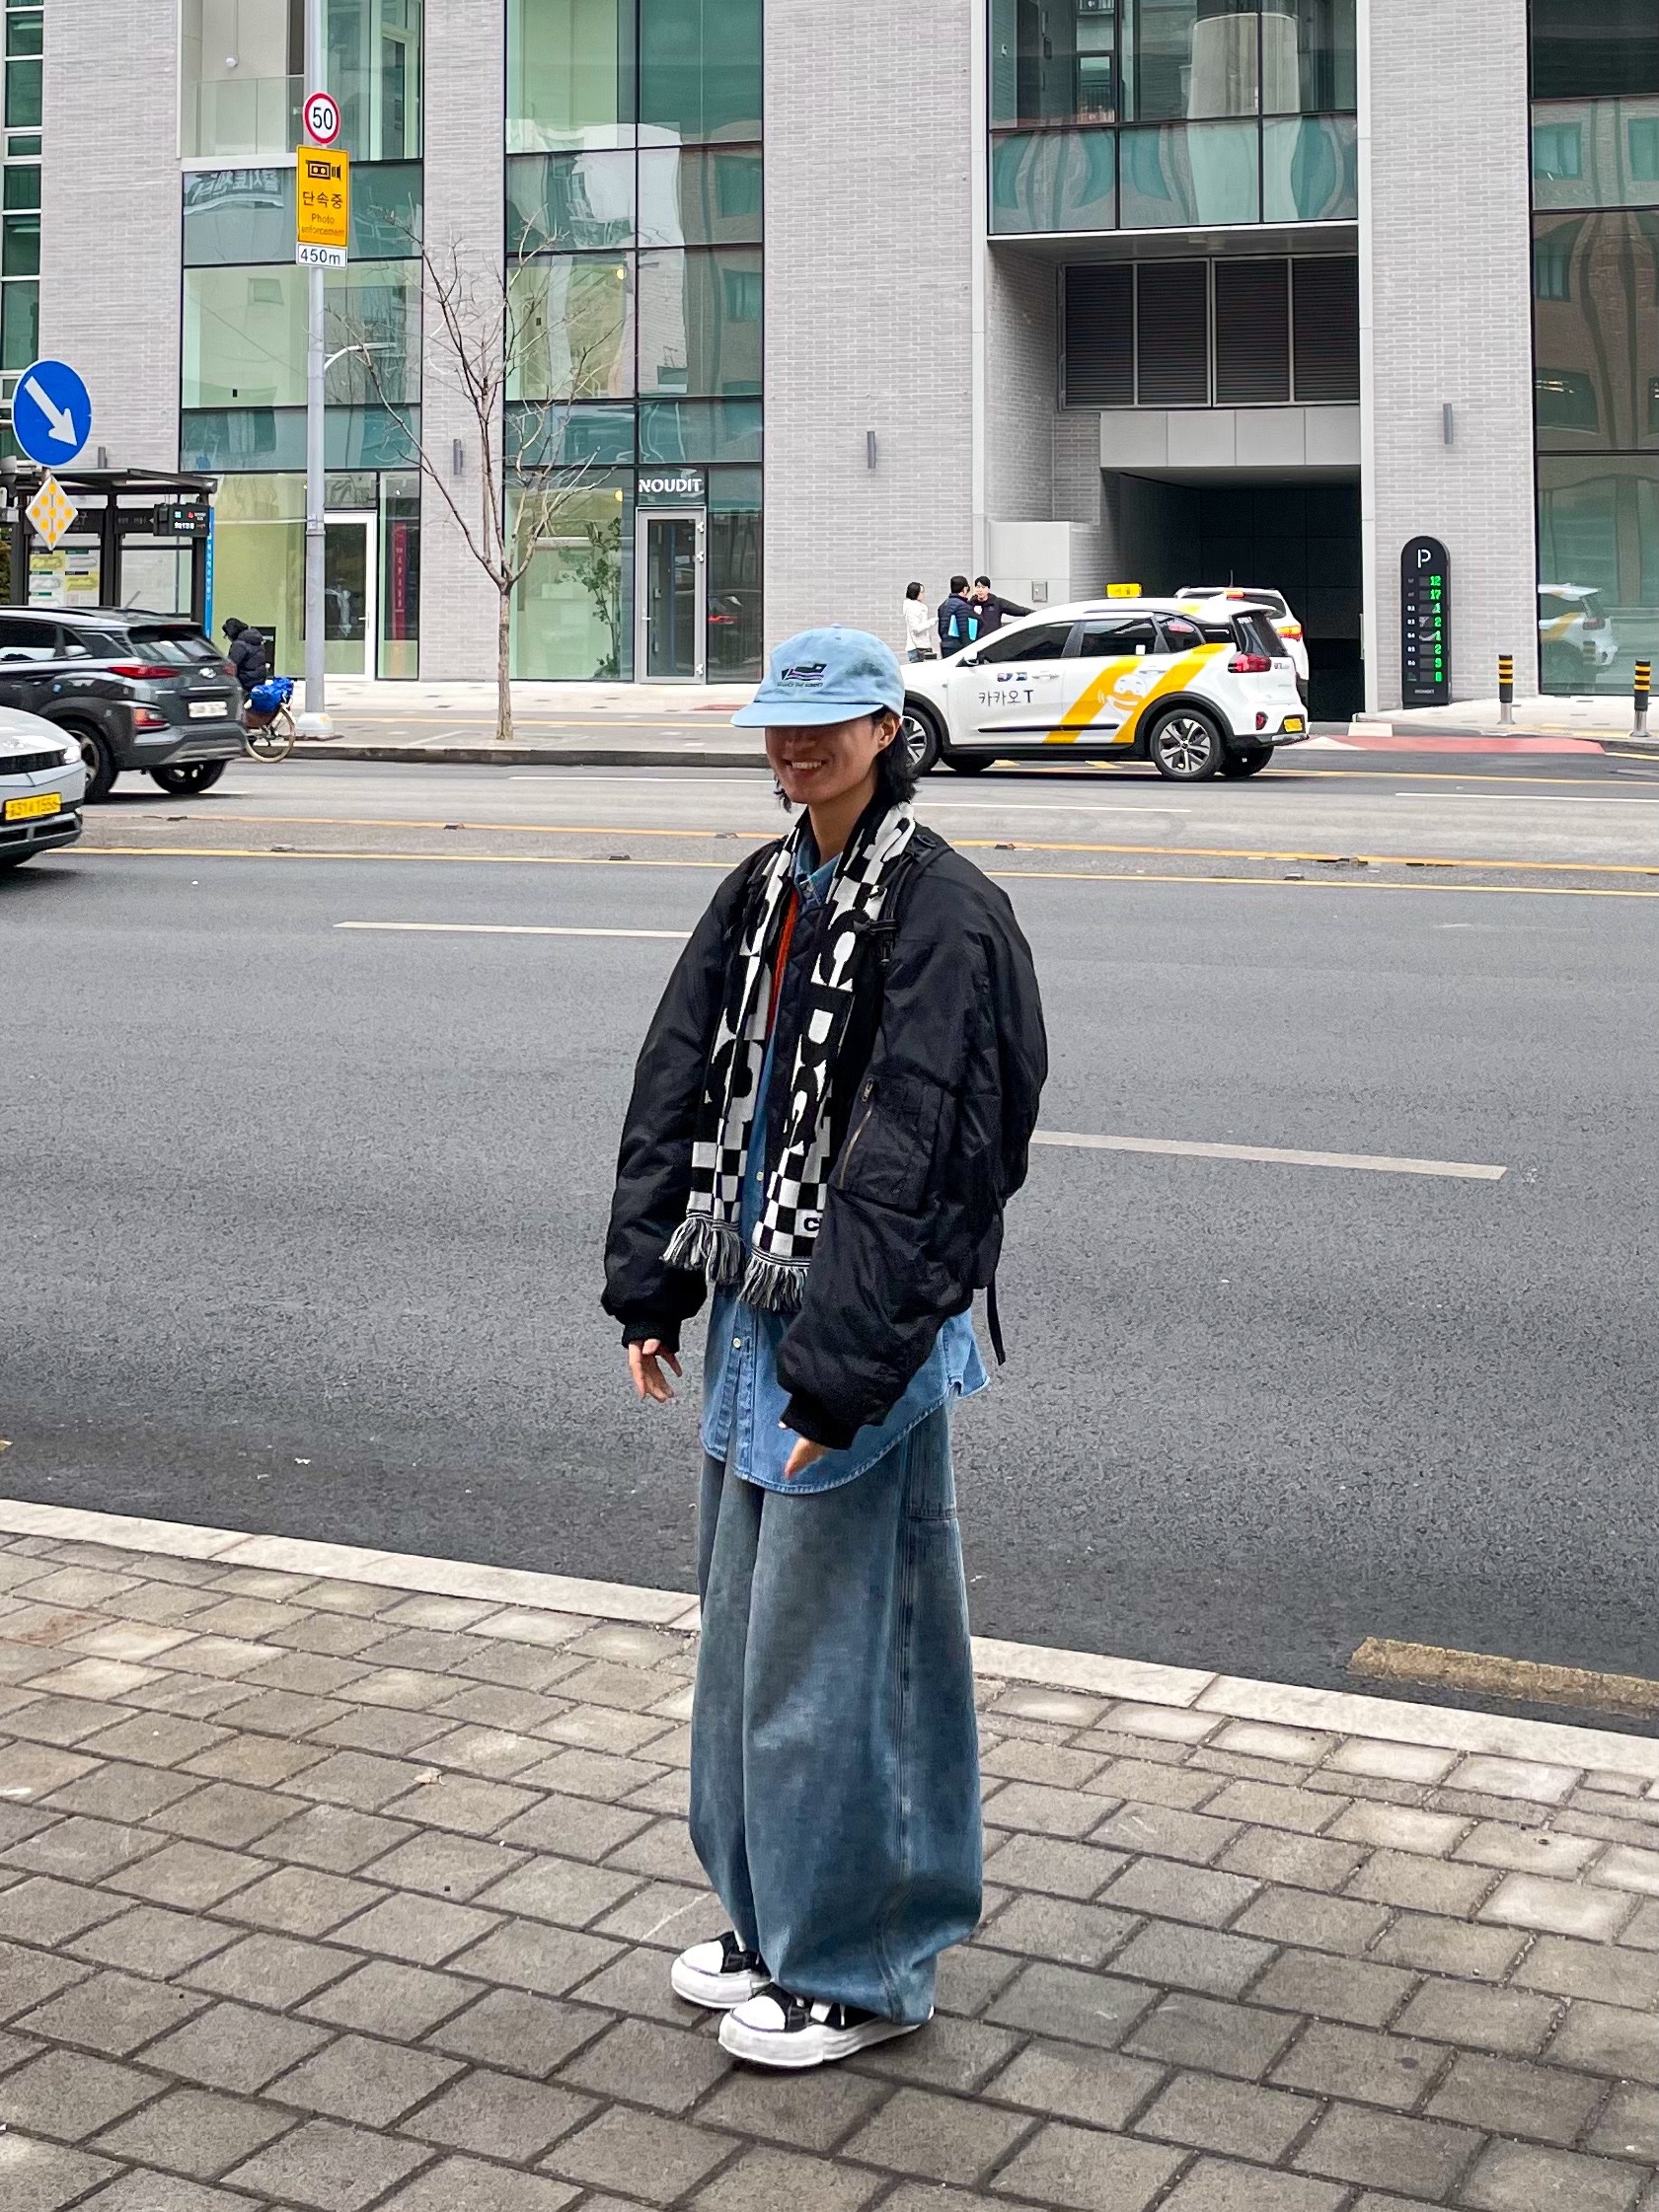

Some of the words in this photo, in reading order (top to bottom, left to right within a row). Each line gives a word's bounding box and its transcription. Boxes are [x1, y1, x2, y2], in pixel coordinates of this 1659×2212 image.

[313, 107, 334, 130] 50
[302, 190, 343, 210] 단속중
[311, 212, 336, 225] Photo
[300, 248, 341, 265] 450m
[639, 479, 703, 493] NOUDIT
[1417, 549, 1432, 569] P
[1429, 575, 1442, 587] 12
[1430, 589, 1442, 600] 17
[1434, 617, 1442, 627] 2
[1434, 643, 1442, 655] 2
[978, 690, 1022, 707] 카카오
[1022, 689, 1034, 703] T
